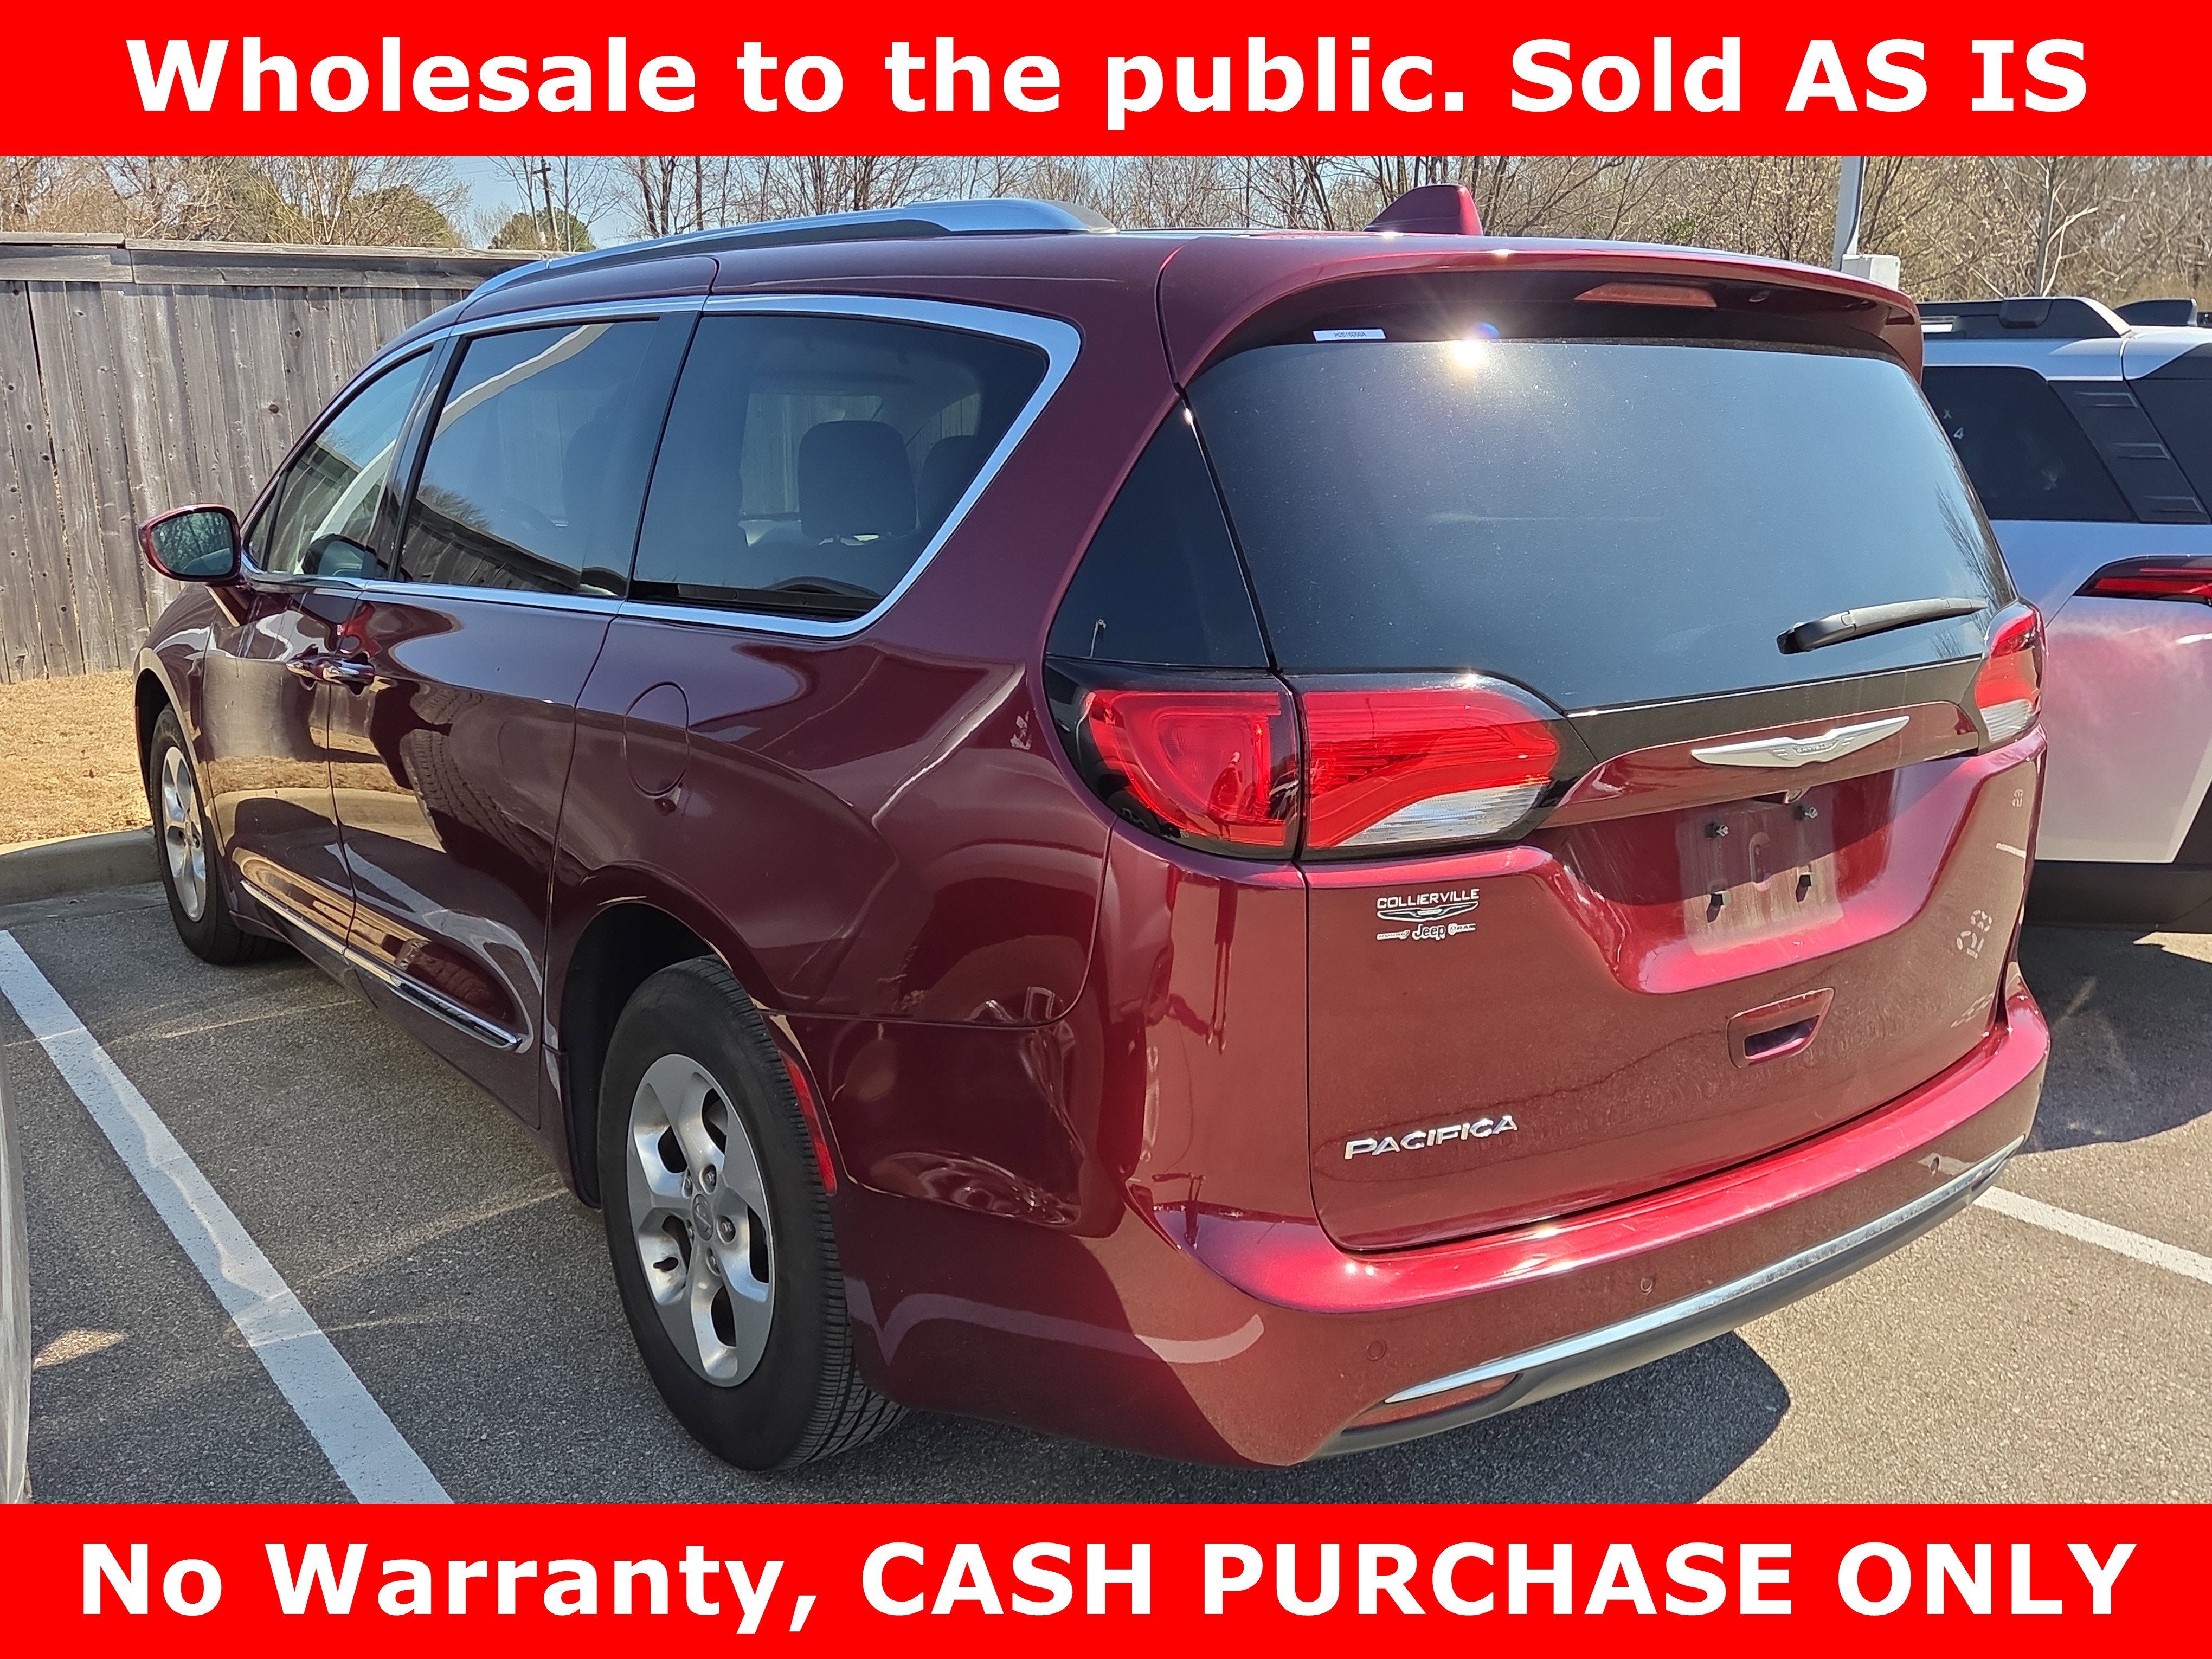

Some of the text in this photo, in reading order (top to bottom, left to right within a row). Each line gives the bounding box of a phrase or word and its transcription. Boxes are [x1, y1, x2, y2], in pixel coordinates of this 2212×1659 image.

[1377, 888, 1480, 909] COLLIERVILLE
[1414, 925, 1445, 938] Jeep
[1344, 1115, 1517, 1160] PACIFICA
